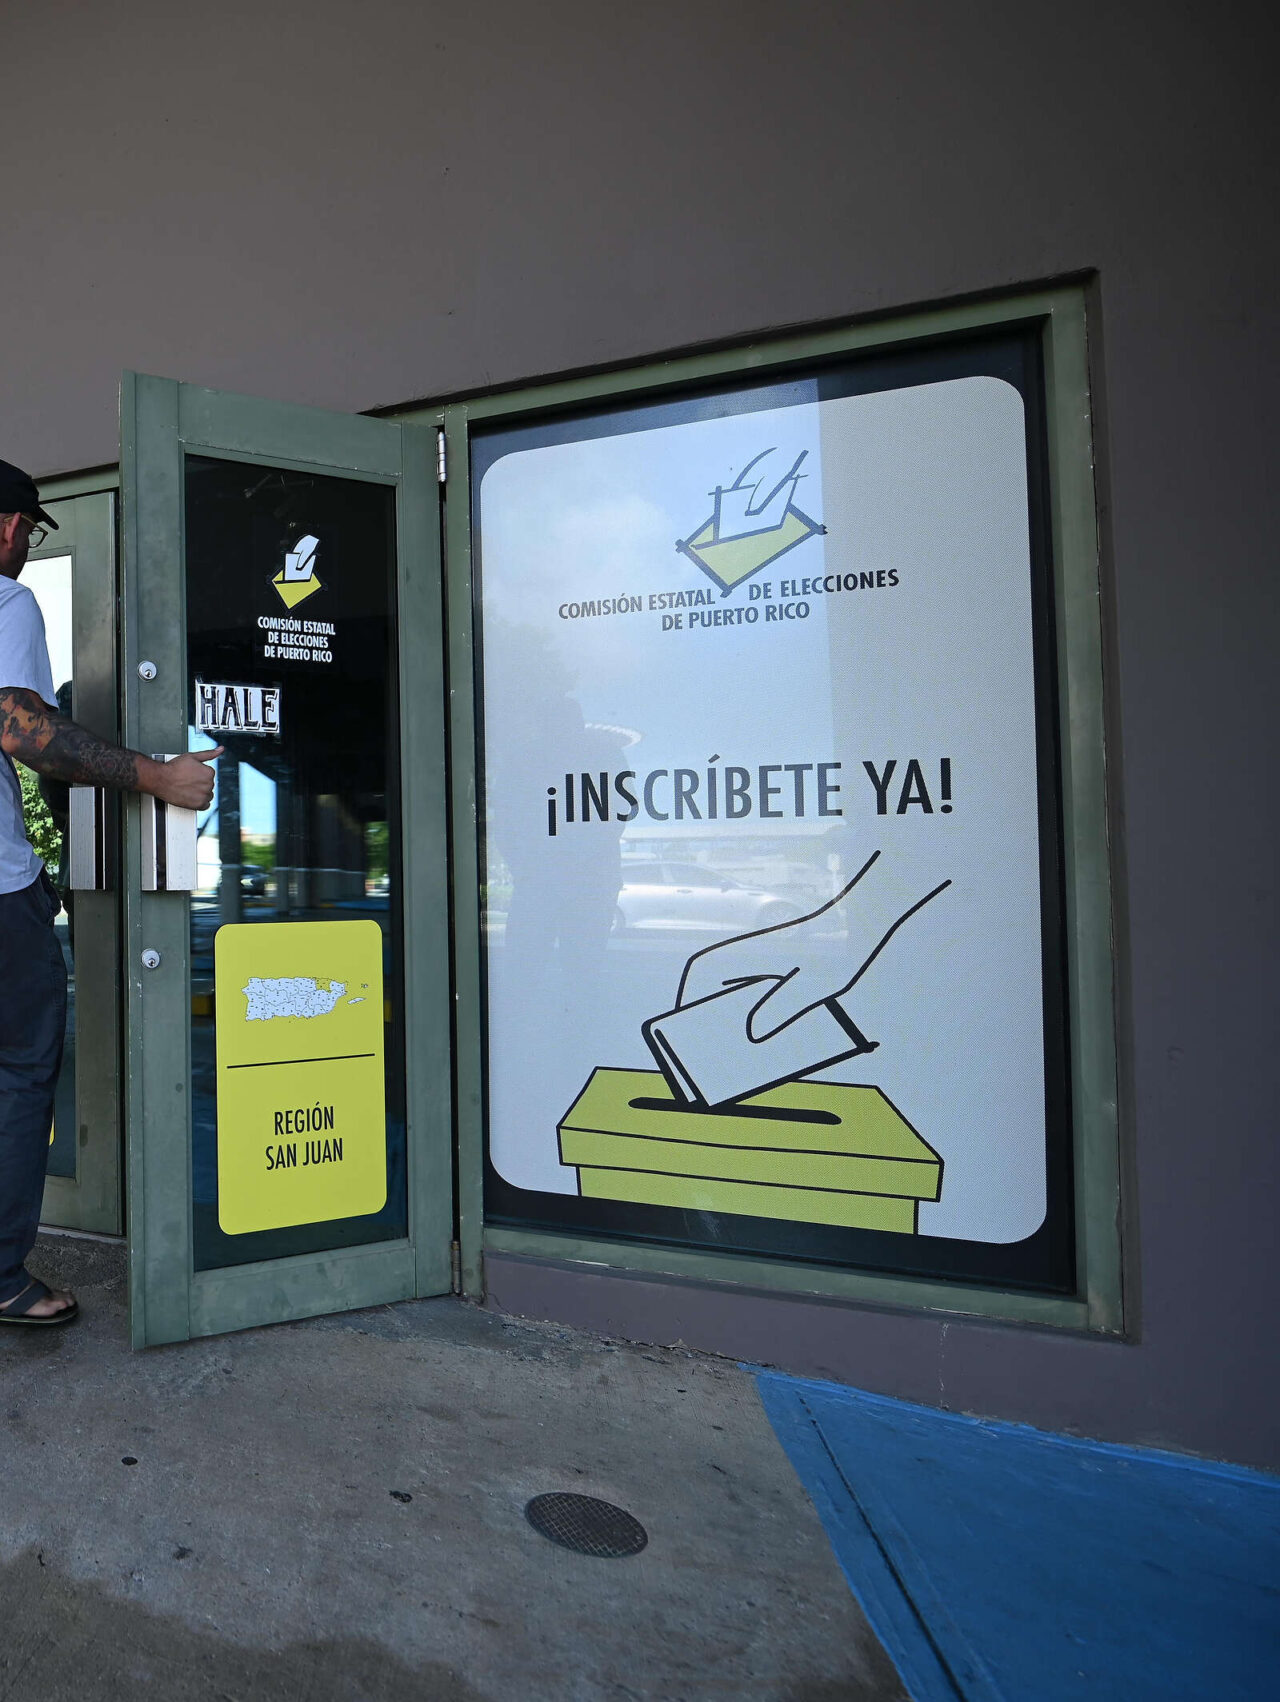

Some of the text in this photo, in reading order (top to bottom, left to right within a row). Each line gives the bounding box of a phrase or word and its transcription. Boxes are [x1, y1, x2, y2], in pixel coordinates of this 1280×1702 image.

[558, 568, 901, 620] COMISIÓN ESTATAL DE ELECCIONES
[257, 616, 336, 636] COMISIÓN ESTATAL
[661, 601, 810, 632] DE PUERTO RICO
[264, 645, 333, 663] DE PUERTO RICO
[268, 631, 329, 649] DE ELECCIONES
[199, 685, 279, 731] HALE
[546, 753, 953, 836] ¡INSCRÍBETE YA!
[274, 1101, 335, 1136] REGIÓN
[265, 1137, 343, 1171] SAN JUAN
